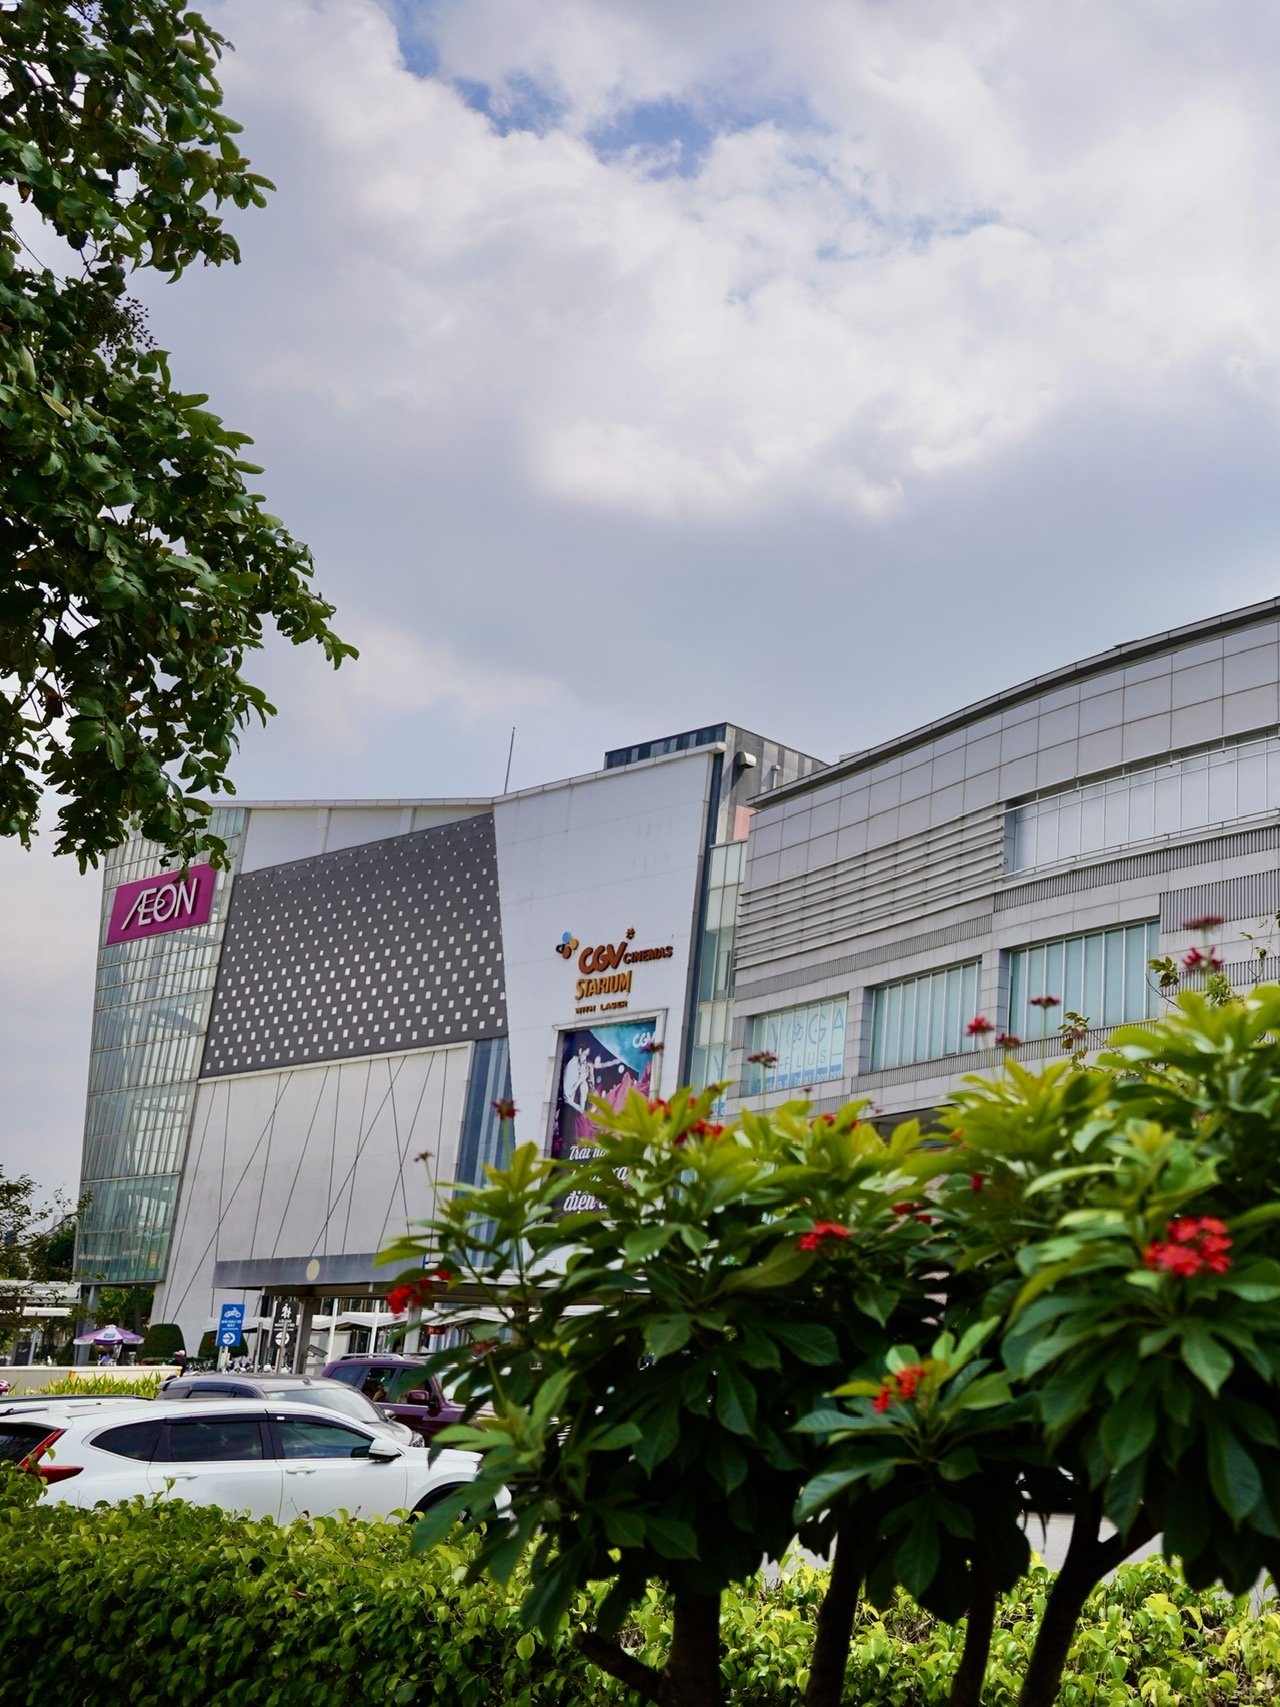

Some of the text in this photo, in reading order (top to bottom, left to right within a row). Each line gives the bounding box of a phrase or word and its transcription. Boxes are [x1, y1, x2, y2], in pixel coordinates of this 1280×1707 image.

[578, 941, 674, 975] CGV CINEMAS
[574, 970, 633, 1001] STARIUM
[575, 1000, 629, 1015] WITH LASER
